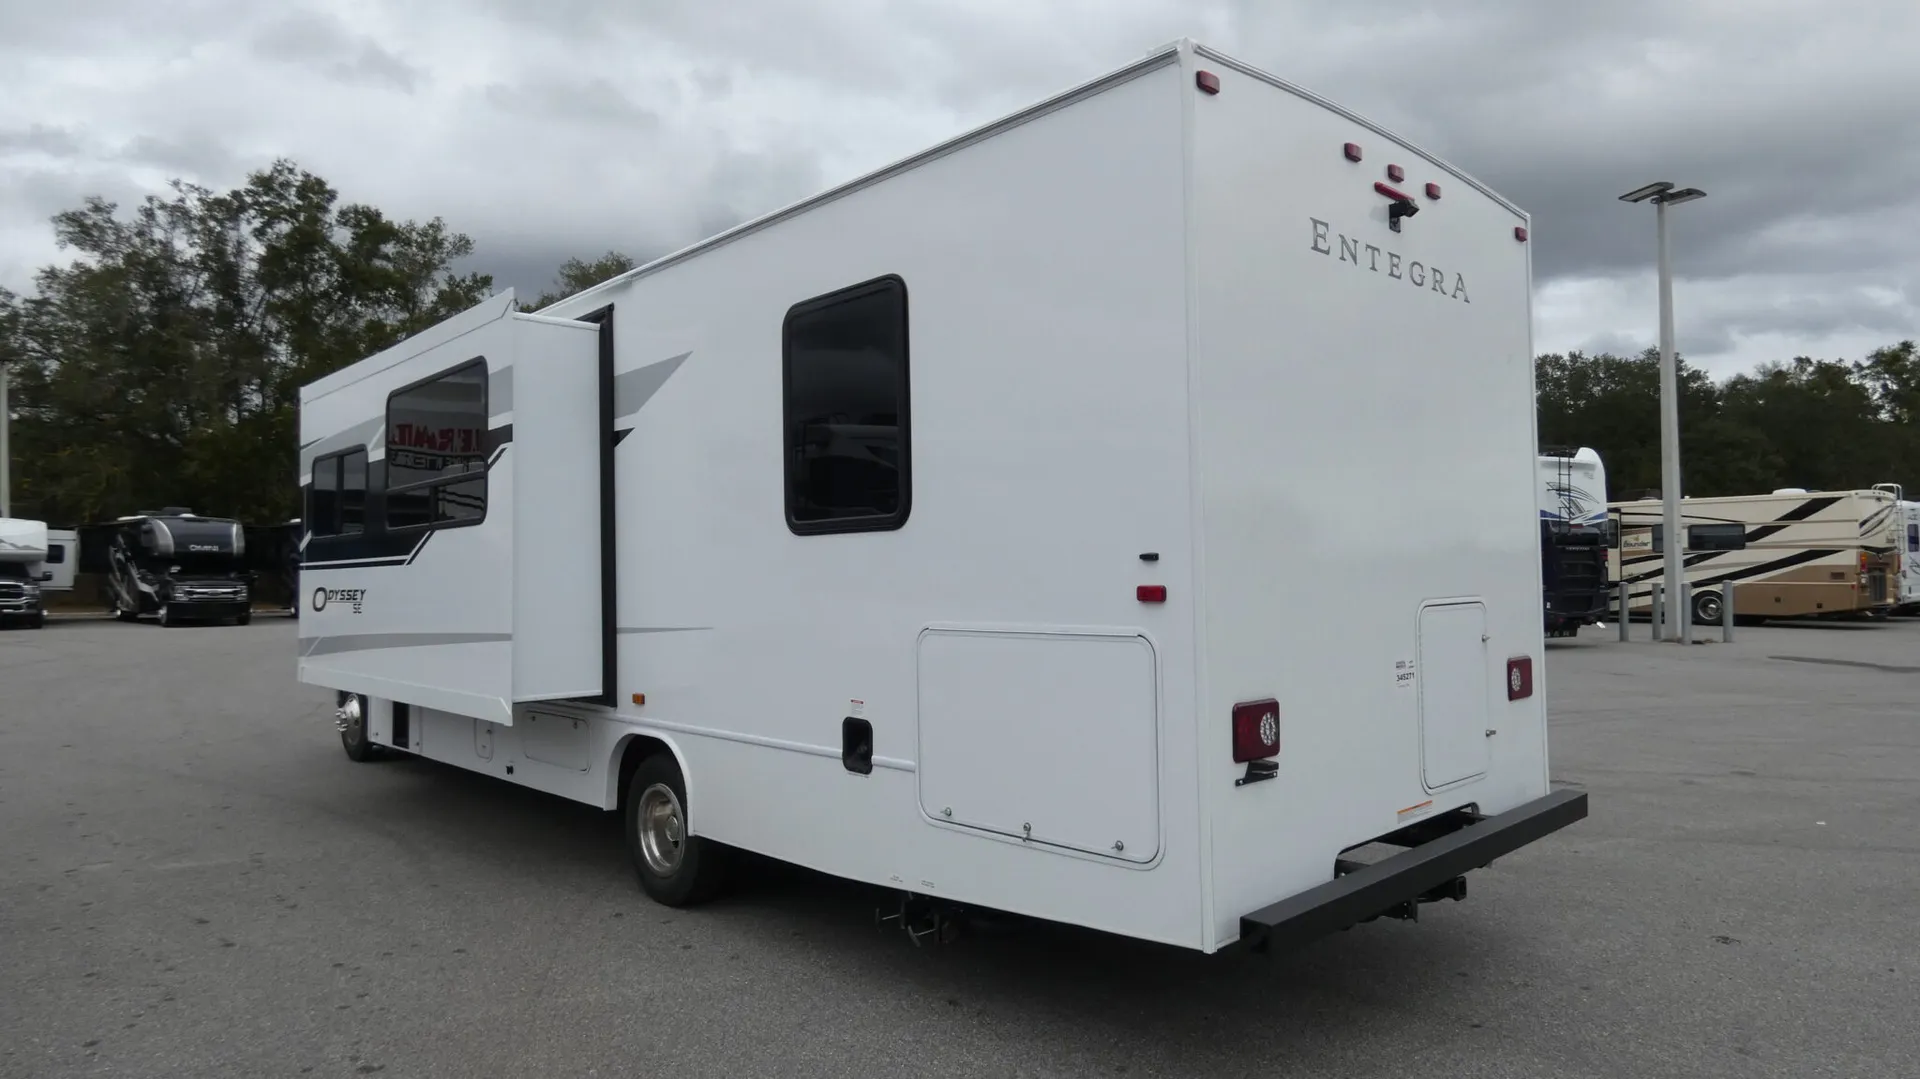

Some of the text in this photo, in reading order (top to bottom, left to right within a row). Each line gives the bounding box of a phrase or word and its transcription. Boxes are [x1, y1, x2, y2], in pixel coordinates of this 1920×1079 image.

[1309, 216, 1471, 304] ENTEGRA
[312, 586, 367, 612] ODYSSEY
[1396, 672, 1415, 682] 345271
